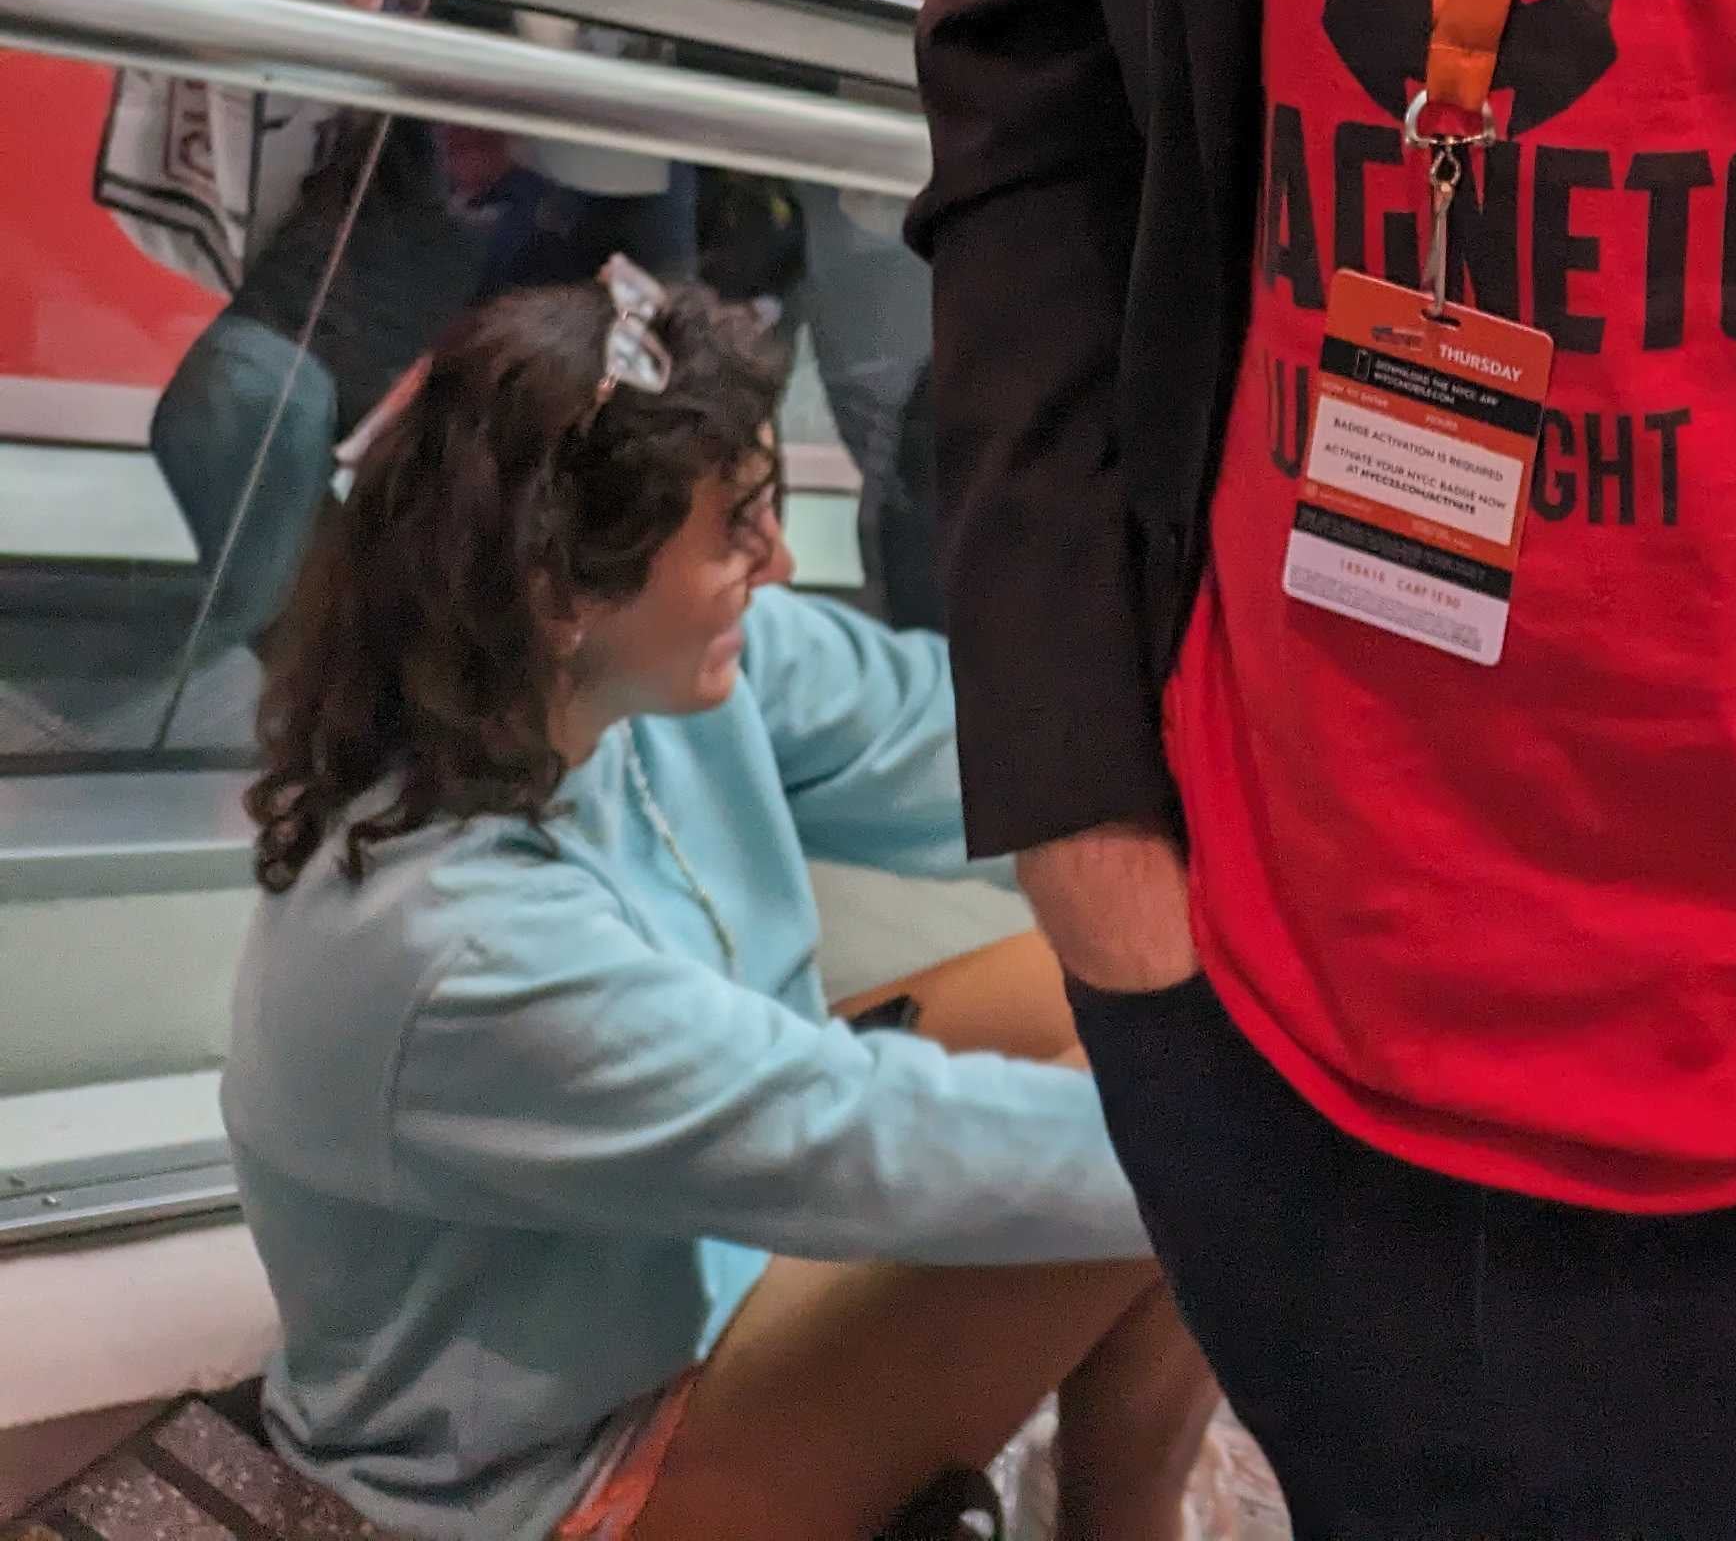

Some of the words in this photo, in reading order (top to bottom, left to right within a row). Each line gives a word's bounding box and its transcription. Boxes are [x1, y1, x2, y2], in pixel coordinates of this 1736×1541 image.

[1438, 344, 1522, 383] THURSDAY
[1324, 443, 1374, 468] ACTIVATE
[1374, 459, 1406, 477] YOUR
[1406, 467, 1438, 488] NYCC
[1439, 479, 1475, 500] BADGE
[1477, 491, 1508, 512] NOW
[1333, 417, 1371, 443] BADGE
[1371, 428, 1436, 460] ACTIVATION
[1436, 452, 1447, 464] IS
[1447, 454, 1505, 483] REQUIRED
[1530, 407, 1692, 527] GHT
